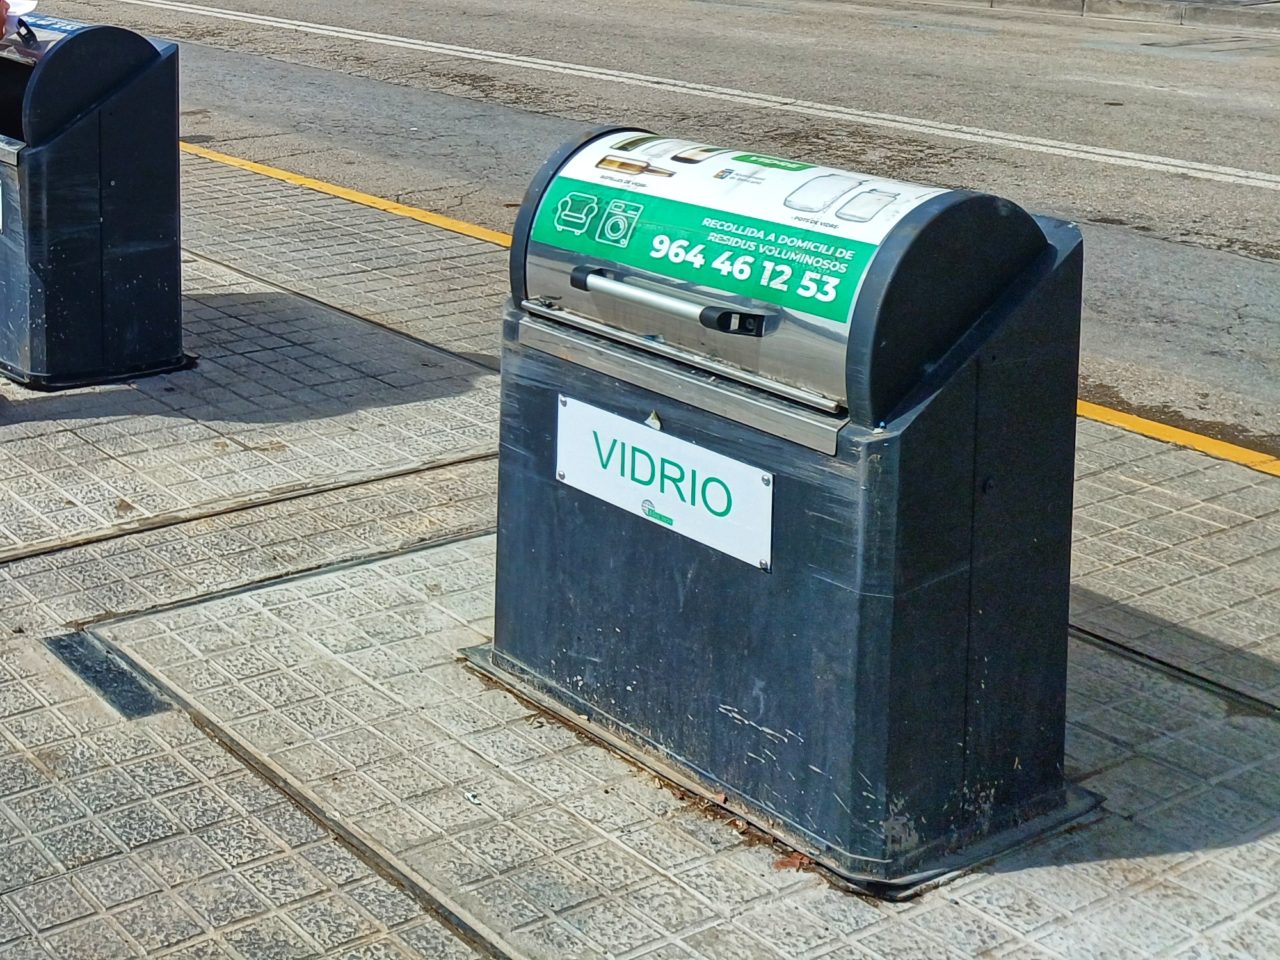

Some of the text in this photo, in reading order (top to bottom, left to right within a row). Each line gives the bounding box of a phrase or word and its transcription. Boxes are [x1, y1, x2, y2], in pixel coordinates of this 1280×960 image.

[701, 217, 855, 261] RECOLLIDA A DOMICILI DE
[707, 232, 849, 273] RESIDUS VOLUMINOSOS
[650, 234, 841, 303] 964 46 12 53
[592, 430, 733, 518] VIDRIO
